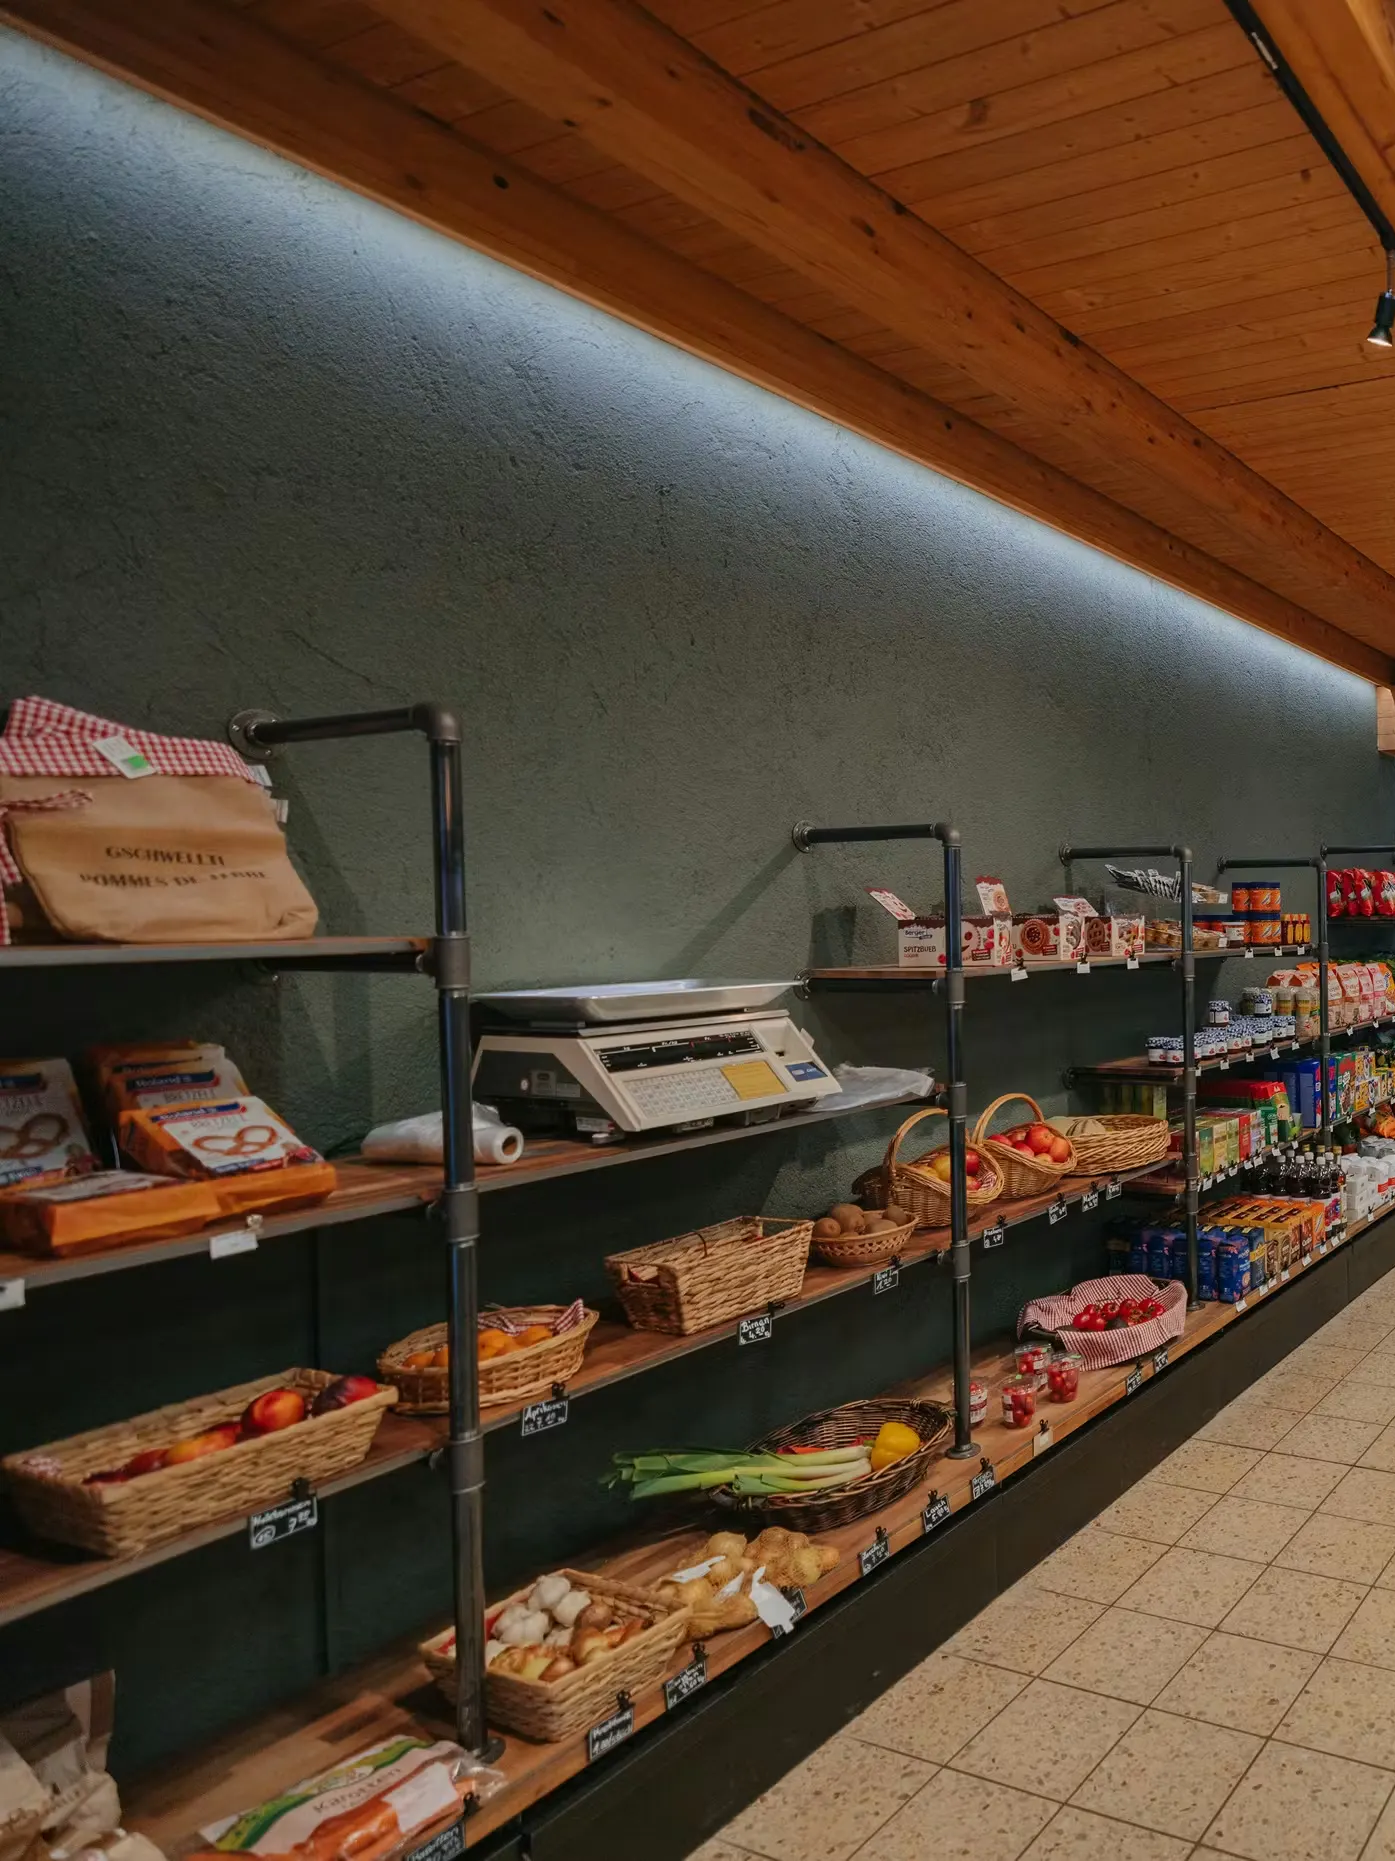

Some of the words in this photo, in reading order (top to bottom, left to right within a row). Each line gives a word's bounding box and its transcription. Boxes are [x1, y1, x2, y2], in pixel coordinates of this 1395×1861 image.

[105, 845, 225, 866] GSCHWELLTI
[903, 945, 937, 953] SPITZBUEB
[925, 1501, 947, 1518] Lauch
[313, 1768, 403, 1815] Karotten
